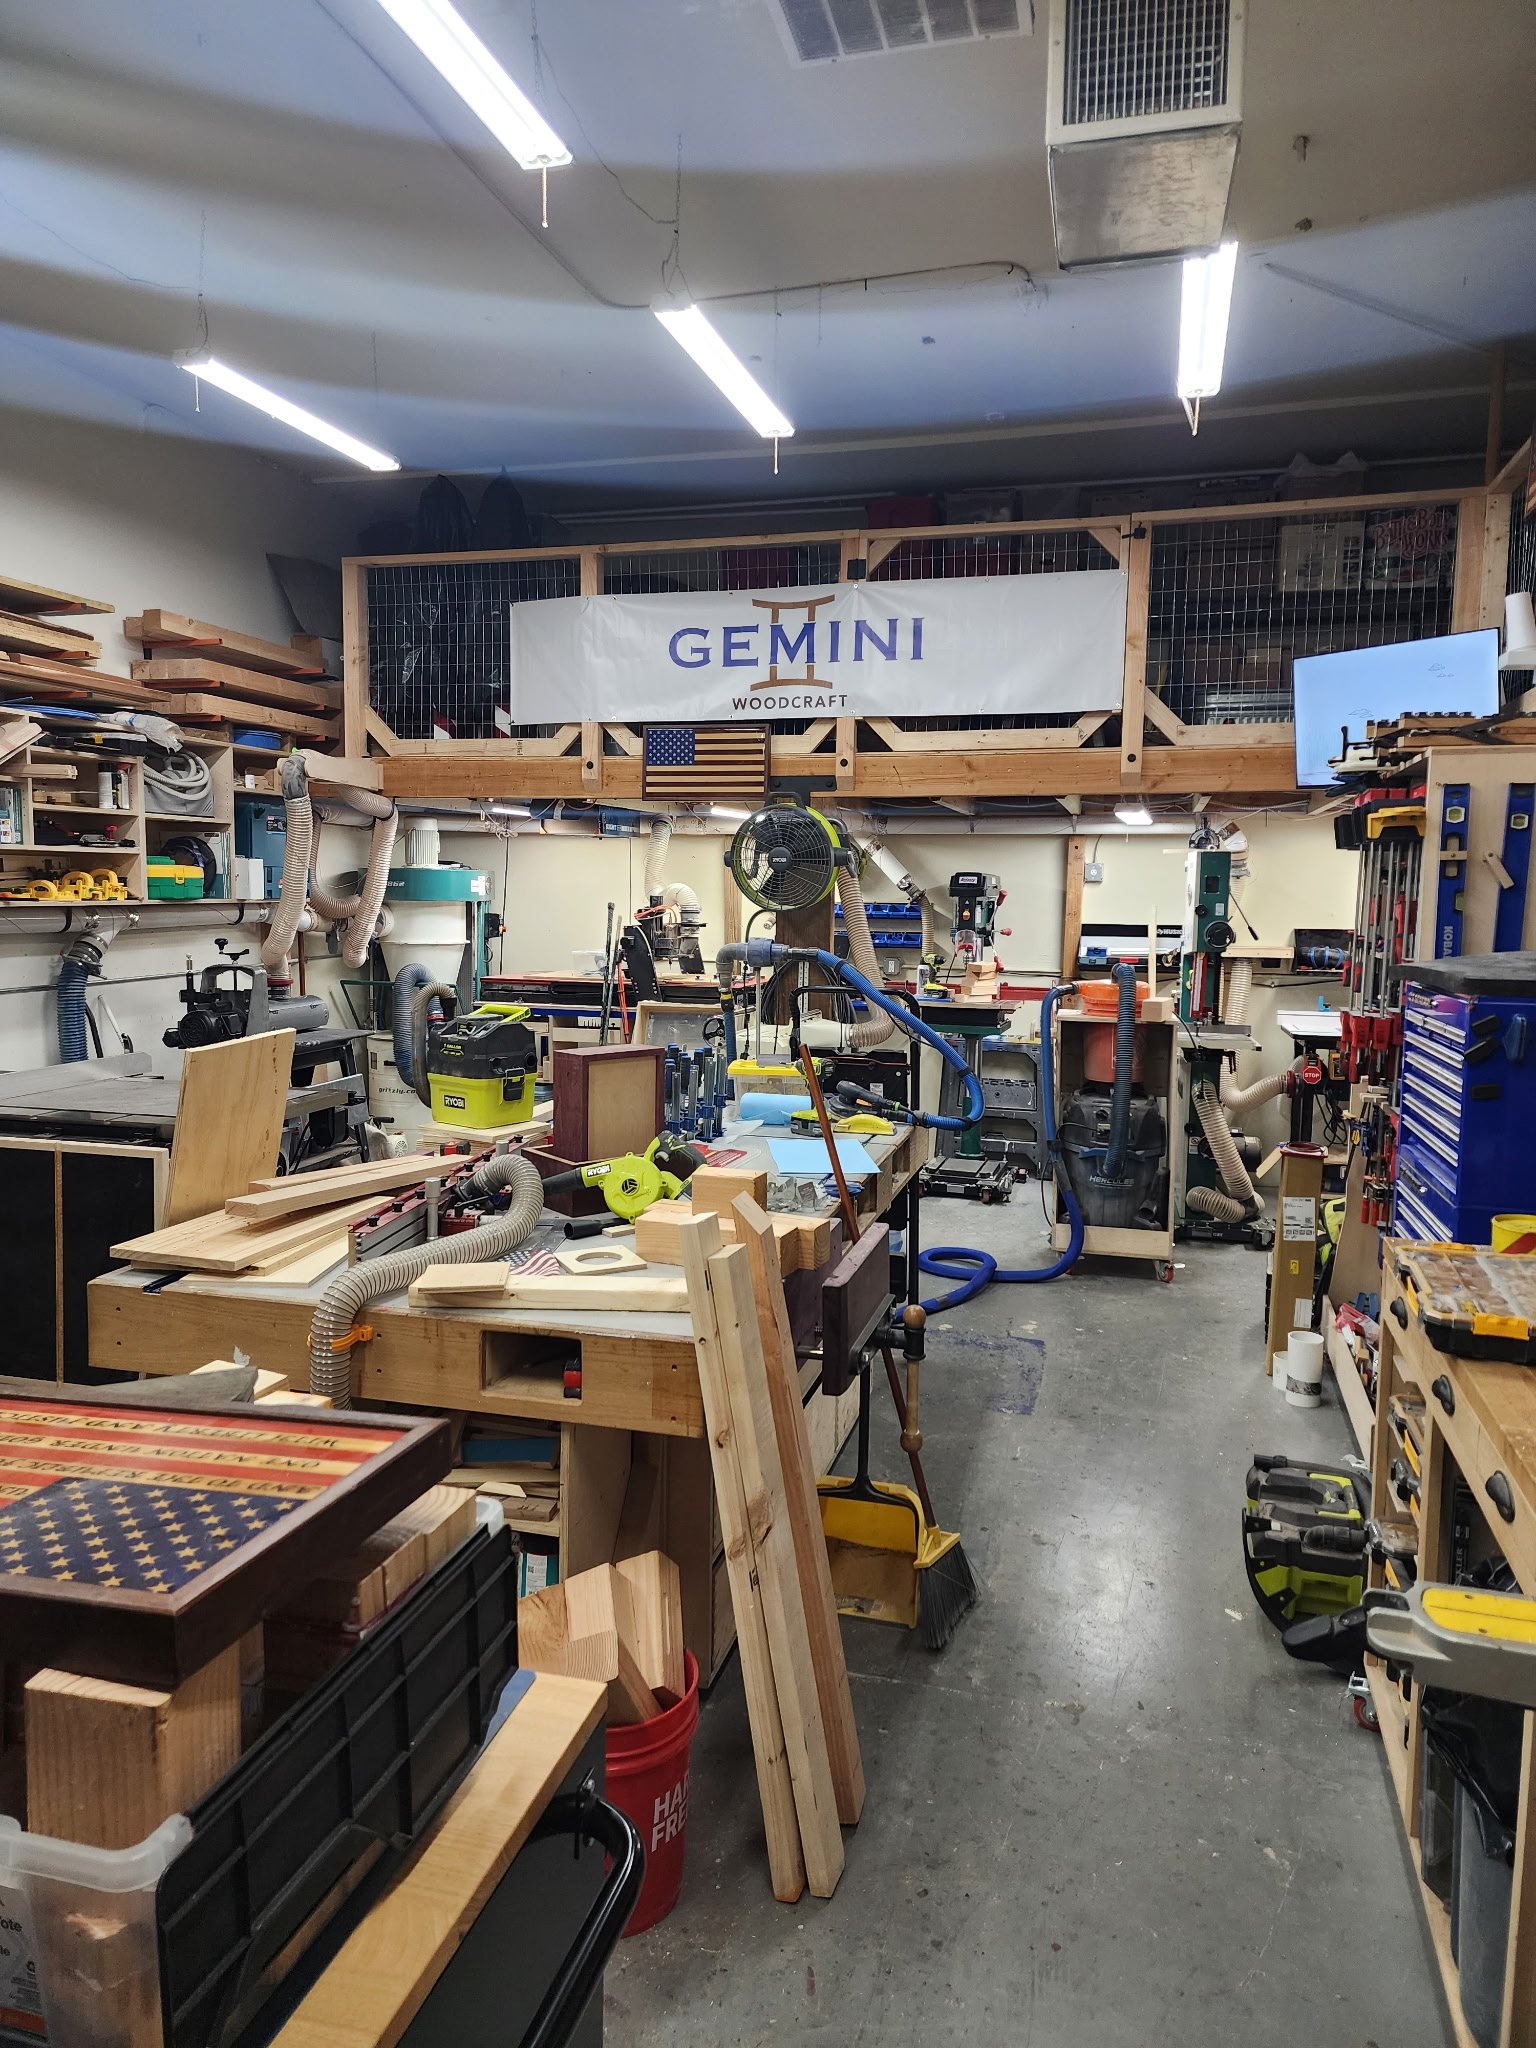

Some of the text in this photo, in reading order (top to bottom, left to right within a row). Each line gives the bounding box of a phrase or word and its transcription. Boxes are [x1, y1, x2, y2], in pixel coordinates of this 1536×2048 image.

[668, 617, 925, 669] GEMINI
[732, 694, 848, 711] WOODCRAFT
[444, 1097, 465, 1108] RYOBI
[587, 1164, 611, 1177] RYOBI
[0, 1411, 83, 1426] JUSTIC
[0, 1916, 23, 1933] ote
